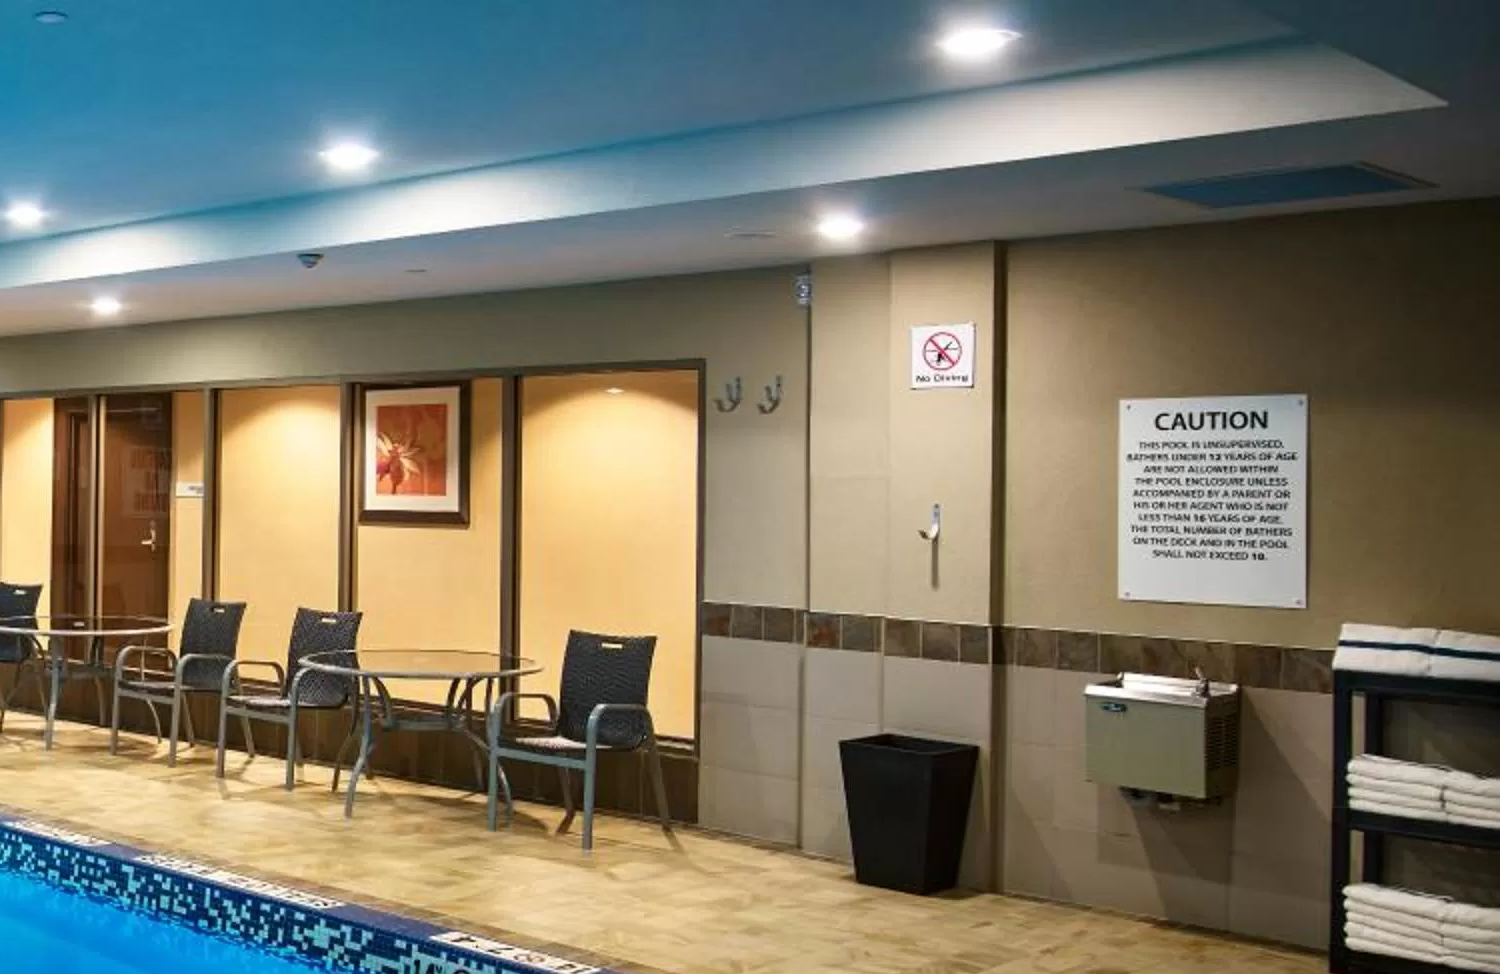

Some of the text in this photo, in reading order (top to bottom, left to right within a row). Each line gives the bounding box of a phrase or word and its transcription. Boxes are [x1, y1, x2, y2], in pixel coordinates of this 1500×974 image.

[1155, 411, 1268, 430] CAUTION
[1139, 441, 1160, 449] THIS
[1162, 441, 1188, 449] POOL
[1191, 441, 1201, 449] IS
[1127, 453, 1169, 461] BATHERS
[1171, 453, 1207, 461] UNDER
[1224, 453, 1257, 461] YEARS
[1259, 453, 1273, 461] OF
[1275, 452, 1298, 460] AGE
[1187, 466, 1238, 474] ALLOWED
[1239, 465, 1279, 473] WITHIN
[1155, 478, 1182, 486] POOL
[1185, 478, 1245, 486] ENCLOSURE
[1247, 478, 1288, 486] UNLESS
[1132, 490, 1291, 498] ACCOMPANIED BY A PARENT OR
[1190, 502, 1223, 510] AGENT
[1225, 502, 1252, 510] WHO
[1266, 502, 1289, 510] NOT
[1208, 514, 1240, 522] YEARS
[1131, 525, 1293, 536] THE TOTAL NUMBER OF BATHERS
[1151, 537, 1169, 545] THE
[1170, 538, 1197, 546] DECK
[1199, 539, 1222, 547] AND
[1224, 539, 1236, 547] IN
[1238, 540, 1257, 548] THE
[1259, 540, 1289, 548] POOL
[1152, 550, 1184, 558] SHALL
[1186, 550, 1206, 558] NOT
[1209, 551, 1249, 560] EXCEED
